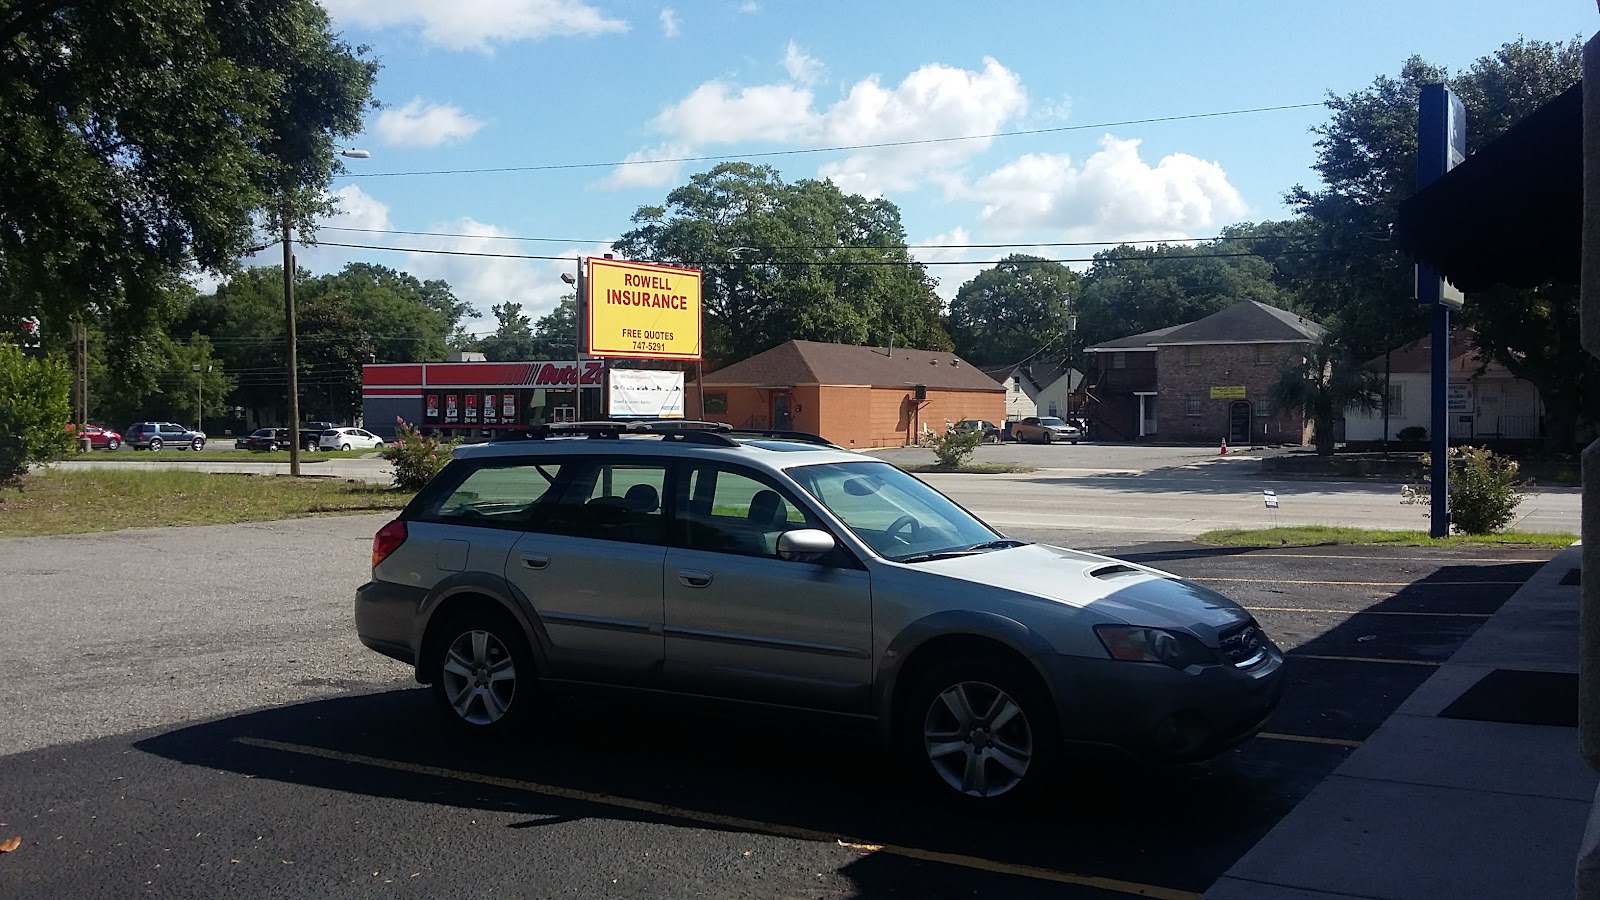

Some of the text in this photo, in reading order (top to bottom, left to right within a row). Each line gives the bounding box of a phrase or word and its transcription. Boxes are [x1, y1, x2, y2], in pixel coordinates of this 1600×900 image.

[624, 273, 672, 291] ROWELL
[607, 288, 688, 310] INSURANCE
[622, 328, 674, 341] FREE QUOTES
[632, 341, 665, 351] 747-5291
